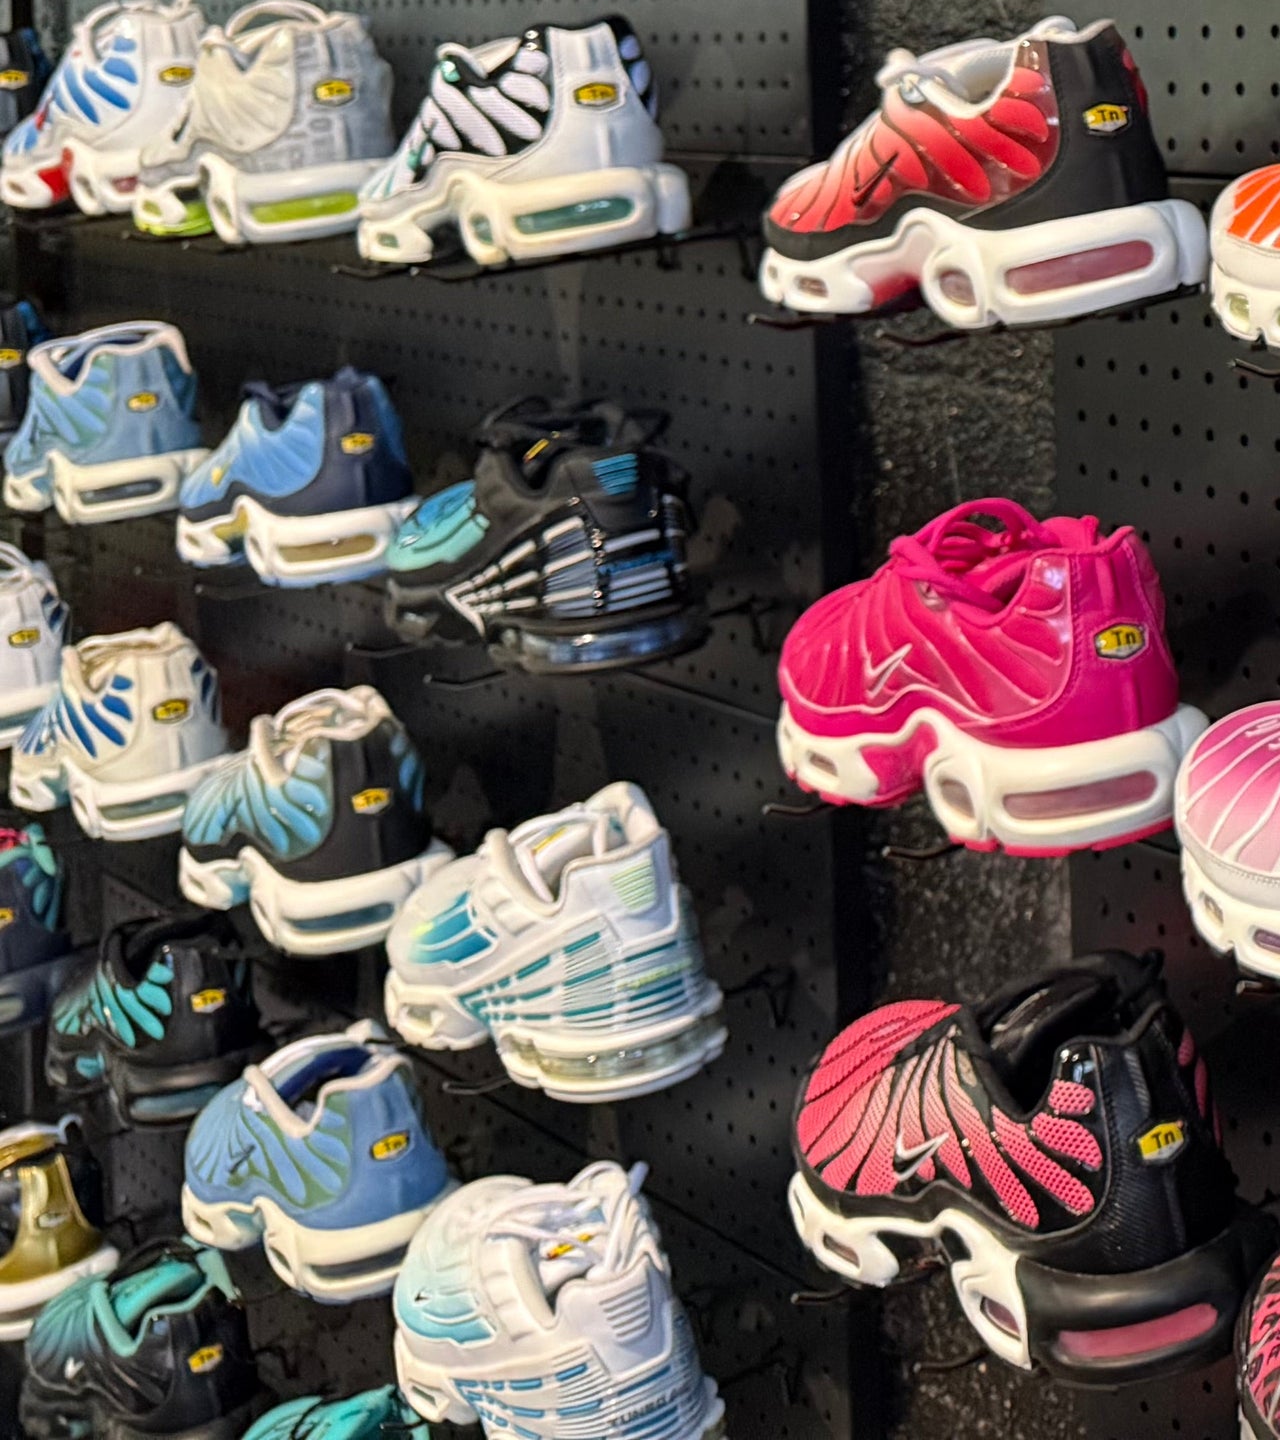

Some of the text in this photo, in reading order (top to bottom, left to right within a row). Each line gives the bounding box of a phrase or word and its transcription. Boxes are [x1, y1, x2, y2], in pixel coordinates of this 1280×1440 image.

[1097, 109, 1120, 122] Tn
[1112, 630, 1137, 646] Tn
[1150, 1130, 1176, 1149] Tn
